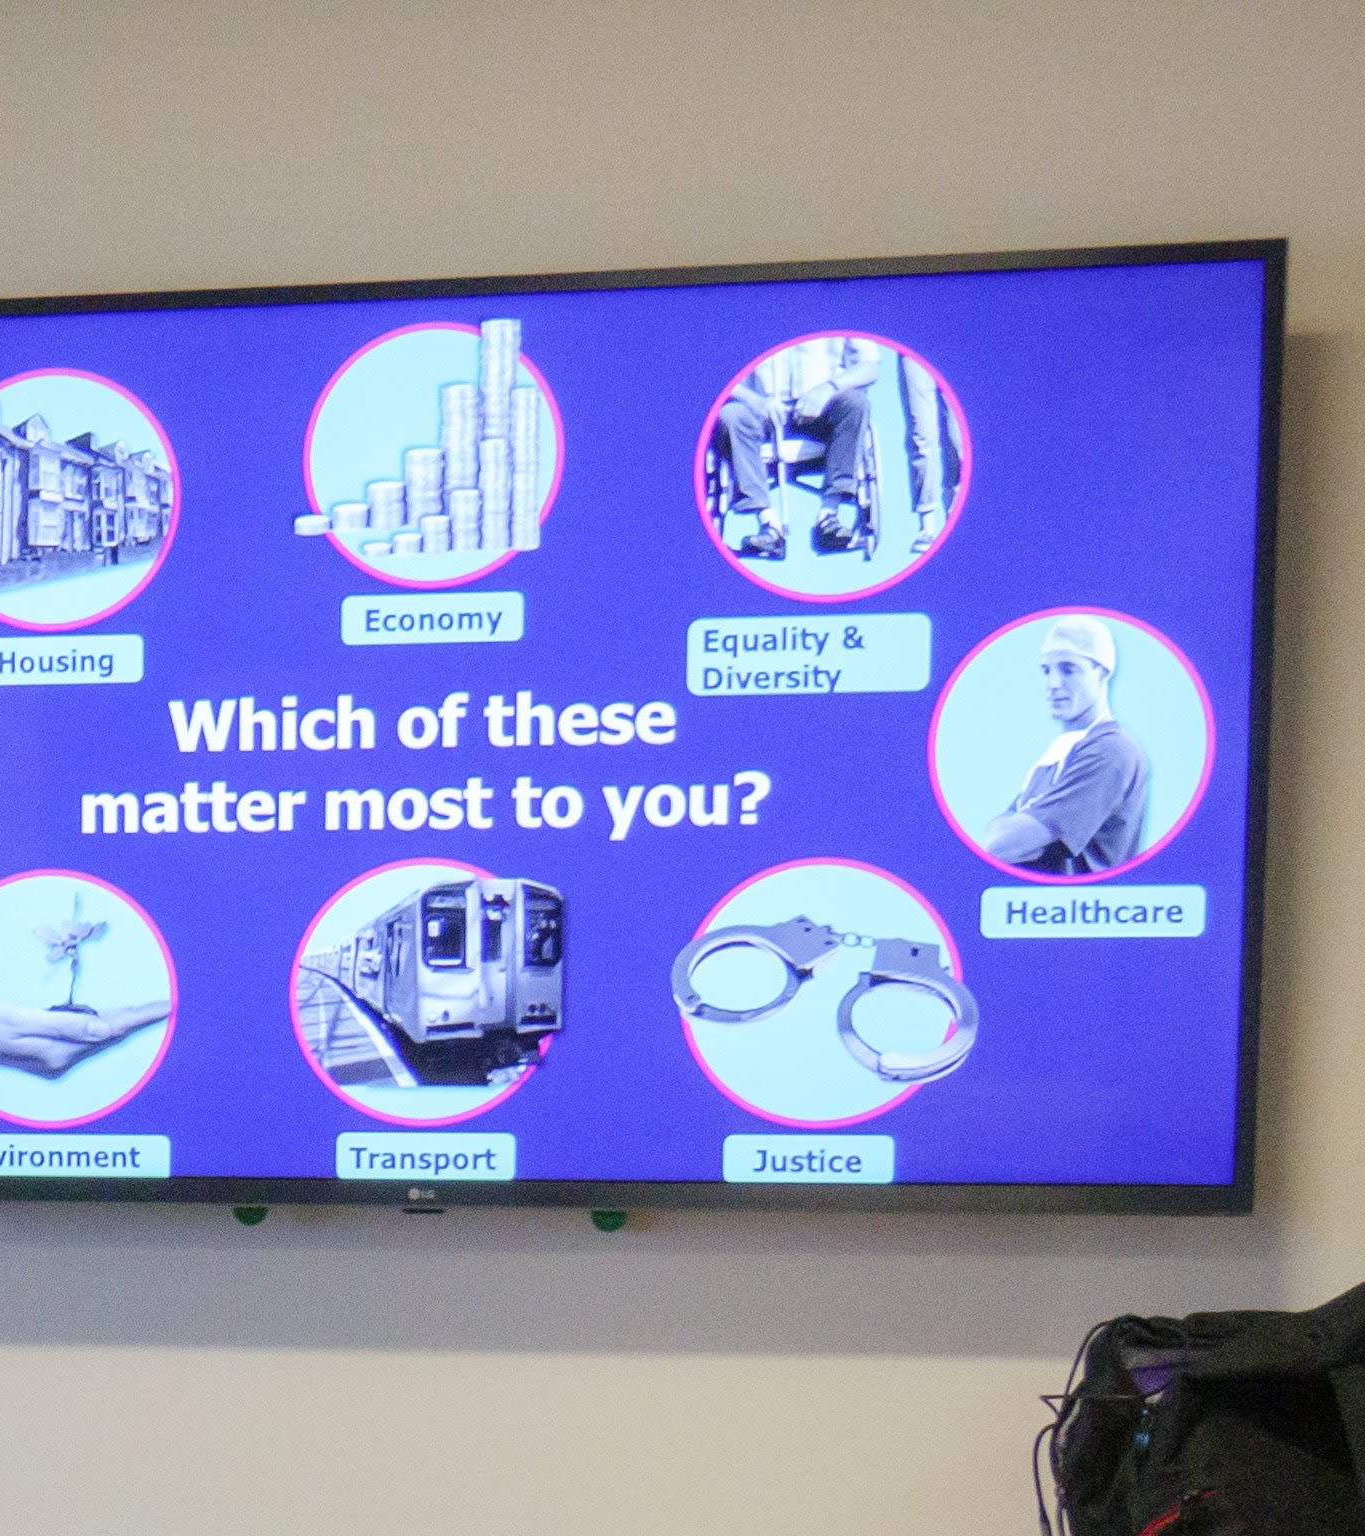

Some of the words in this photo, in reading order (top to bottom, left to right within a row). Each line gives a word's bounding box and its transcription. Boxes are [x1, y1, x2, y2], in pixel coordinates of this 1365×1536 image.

[364, 608, 502, 636] Economy
[702, 626, 830, 658] Equality
[842, 625, 865, 651] &
[702, 663, 842, 694] Diversity
[168, 695, 375, 753] Which
[397, 692, 469, 750] of
[483, 691, 677, 748] these
[81, 782, 307, 834] matter
[325, 777, 494, 831] most
[511, 777, 584, 829] to
[602, 771, 771, 841] you?
[1006, 899, 1184, 925] Healthcare
[349, 1146, 497, 1175] Transport
[752, 1149, 862, 1174] Justice
